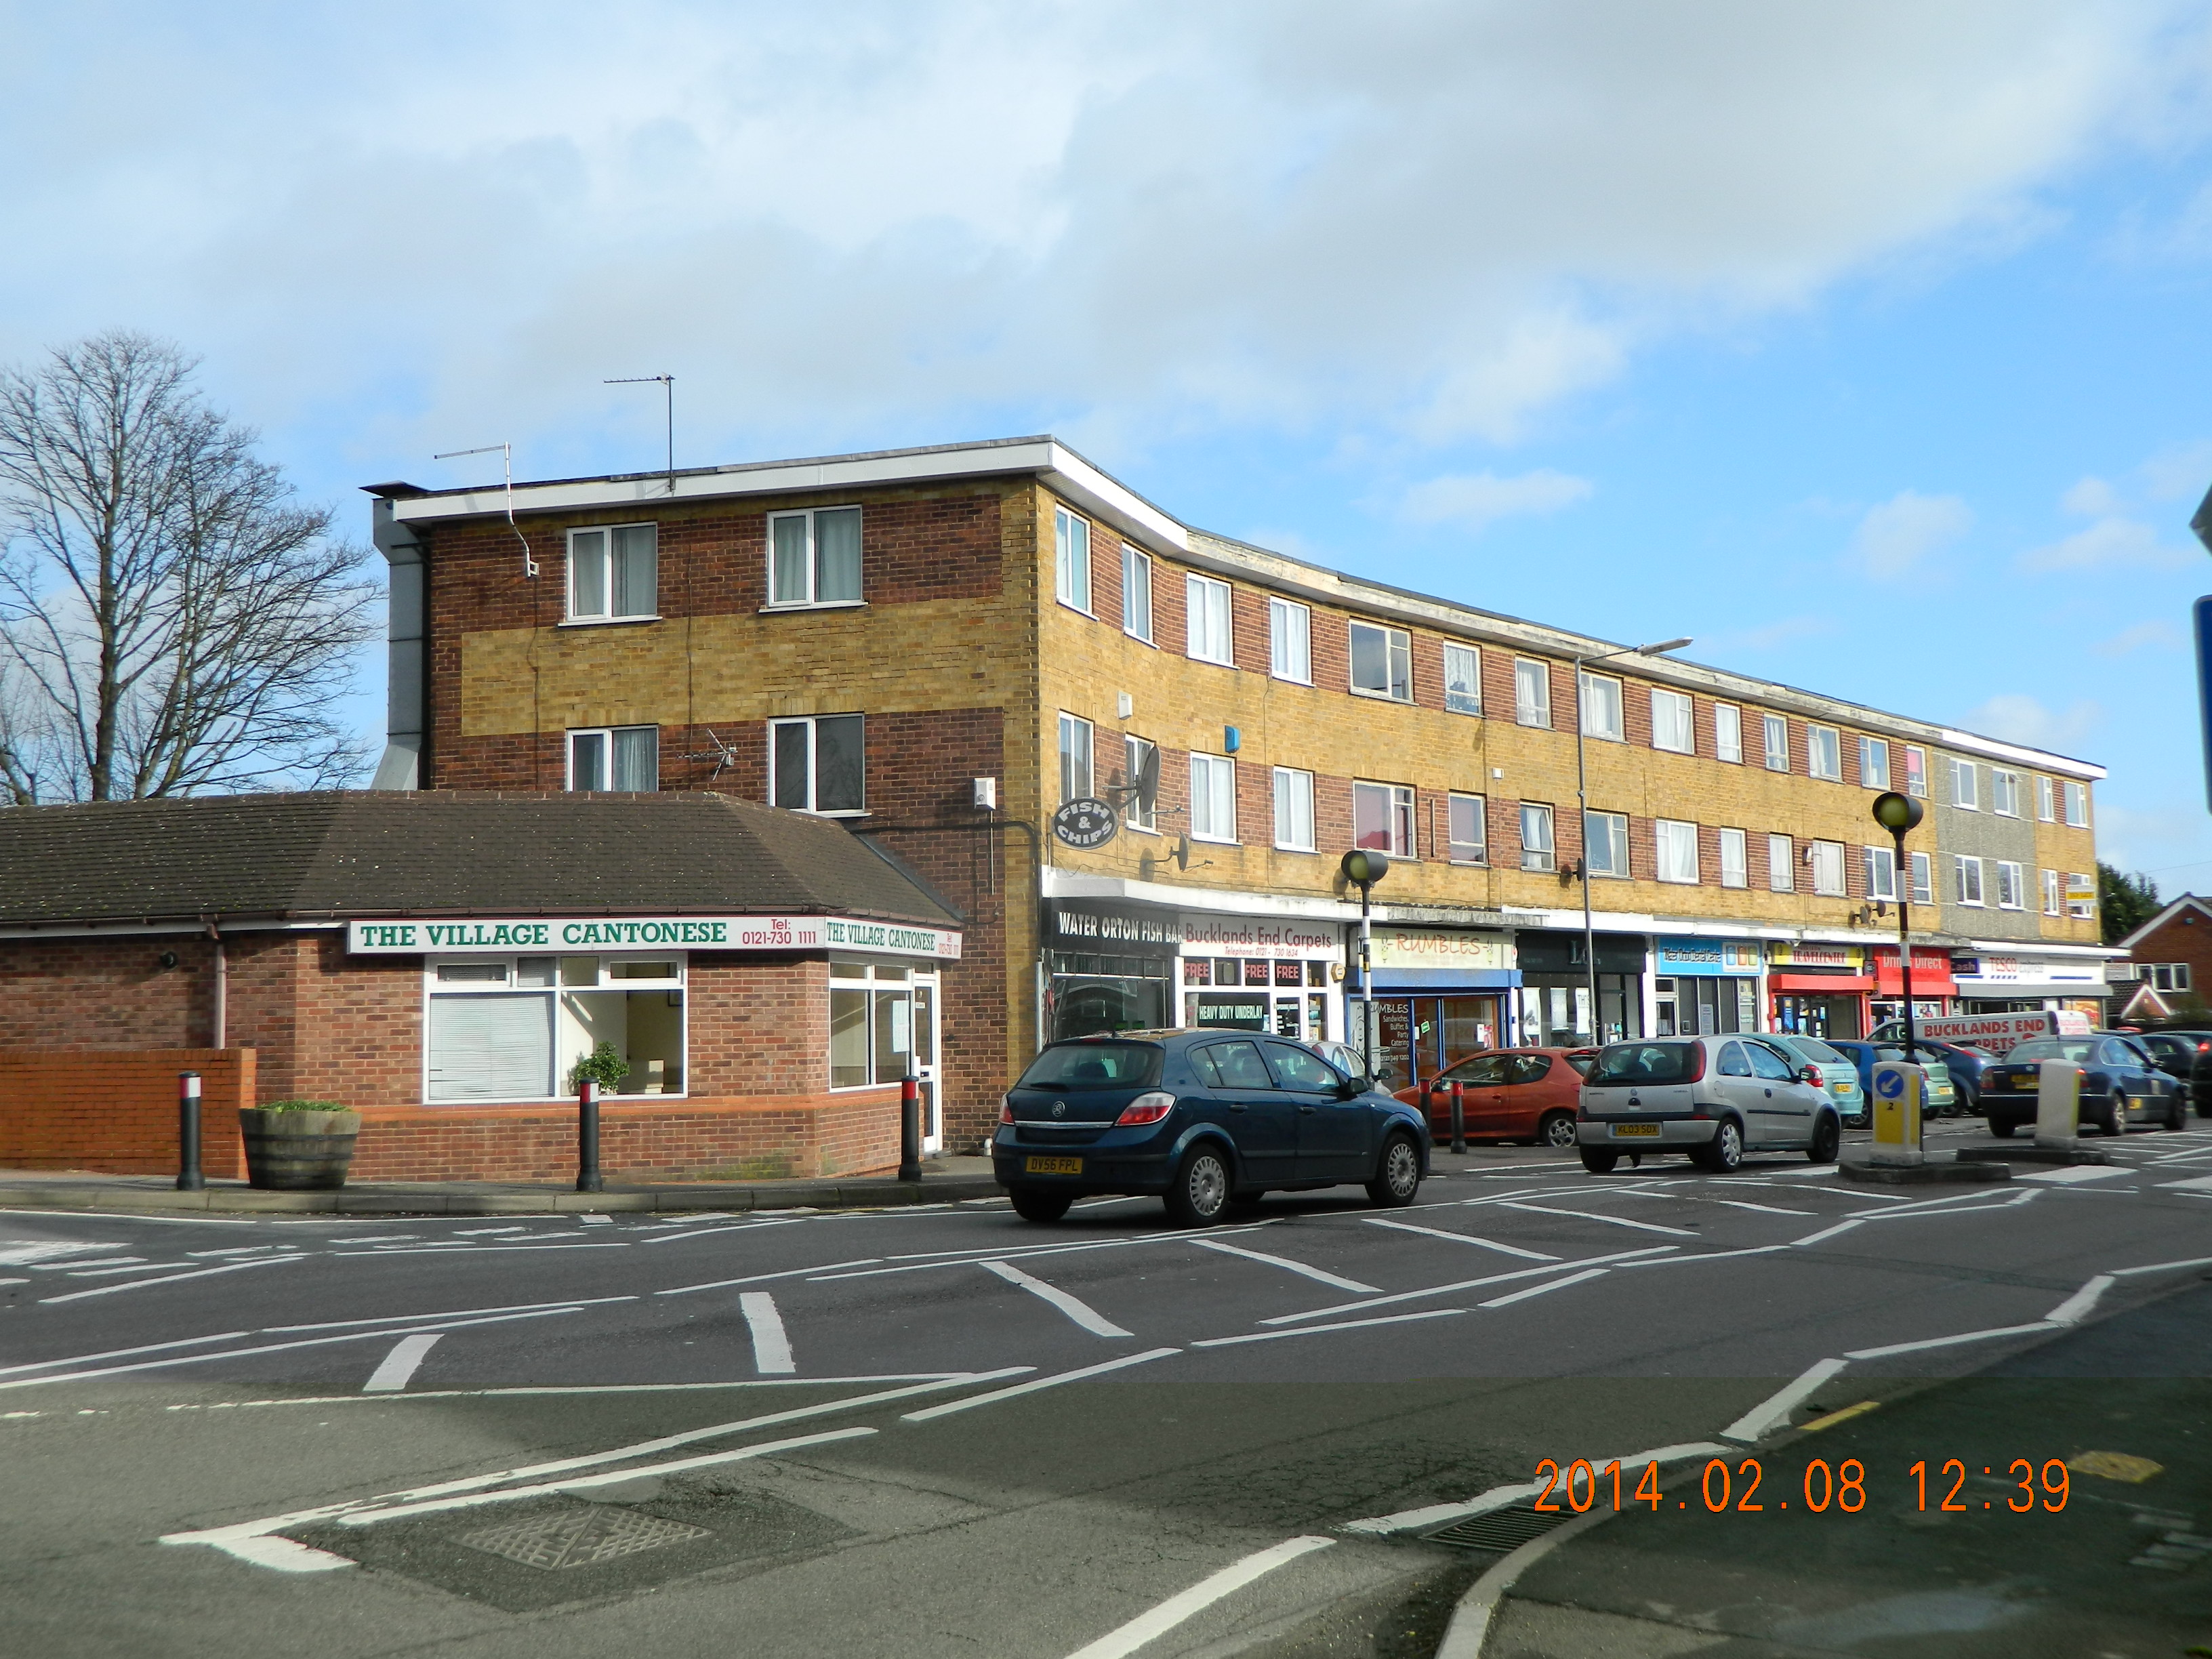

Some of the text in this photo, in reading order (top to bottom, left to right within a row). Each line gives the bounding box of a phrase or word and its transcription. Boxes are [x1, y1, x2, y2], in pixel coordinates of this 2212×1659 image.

[1059, 802, 1110, 822] FISH
[1078, 816, 1091, 829] &
[1057, 820, 1112, 844] CHIPS
[771, 919, 791, 930] Tel:
[1059, 912, 1183, 944] WATER ORTON FISH BAR
[361, 922, 727, 947] THE VILLAGE CANTONESE
[742, 931, 816, 944] 0121-730 1111
[827, 922, 935, 951] THE VILLAGE CANTONESE
[1185, 922, 1332, 951] Bucklands End Carpets
[1396, 933, 1480, 955] RUMBLES
[1225, 946, 1254, 957] Telephone:
[1256, 947, 1267, 956] 0121
[1274, 948, 1284, 956] 730
[1286, 948, 1298, 957] 1634
[1883, 951, 1942, 969] Drins Direct
[1990, 958, 2017, 972] TESCO
[1185, 963, 1209, 977] FREE
[1246, 964, 1268, 978] FREE
[1276, 965, 1299, 979] FREE
[1200, 1006, 1218, 1020] HEAVY
[1219, 1006, 1234, 1019] DUTY
[1235, 1005, 1263, 1019] UNDERLAY
[1924, 1021, 2009, 1036] BUCKLANDS
[2015, 1019, 2045, 1032] END
[1973, 1038, 2015, 1050] PETS
[1059, 1160, 1078, 1171] FPL
